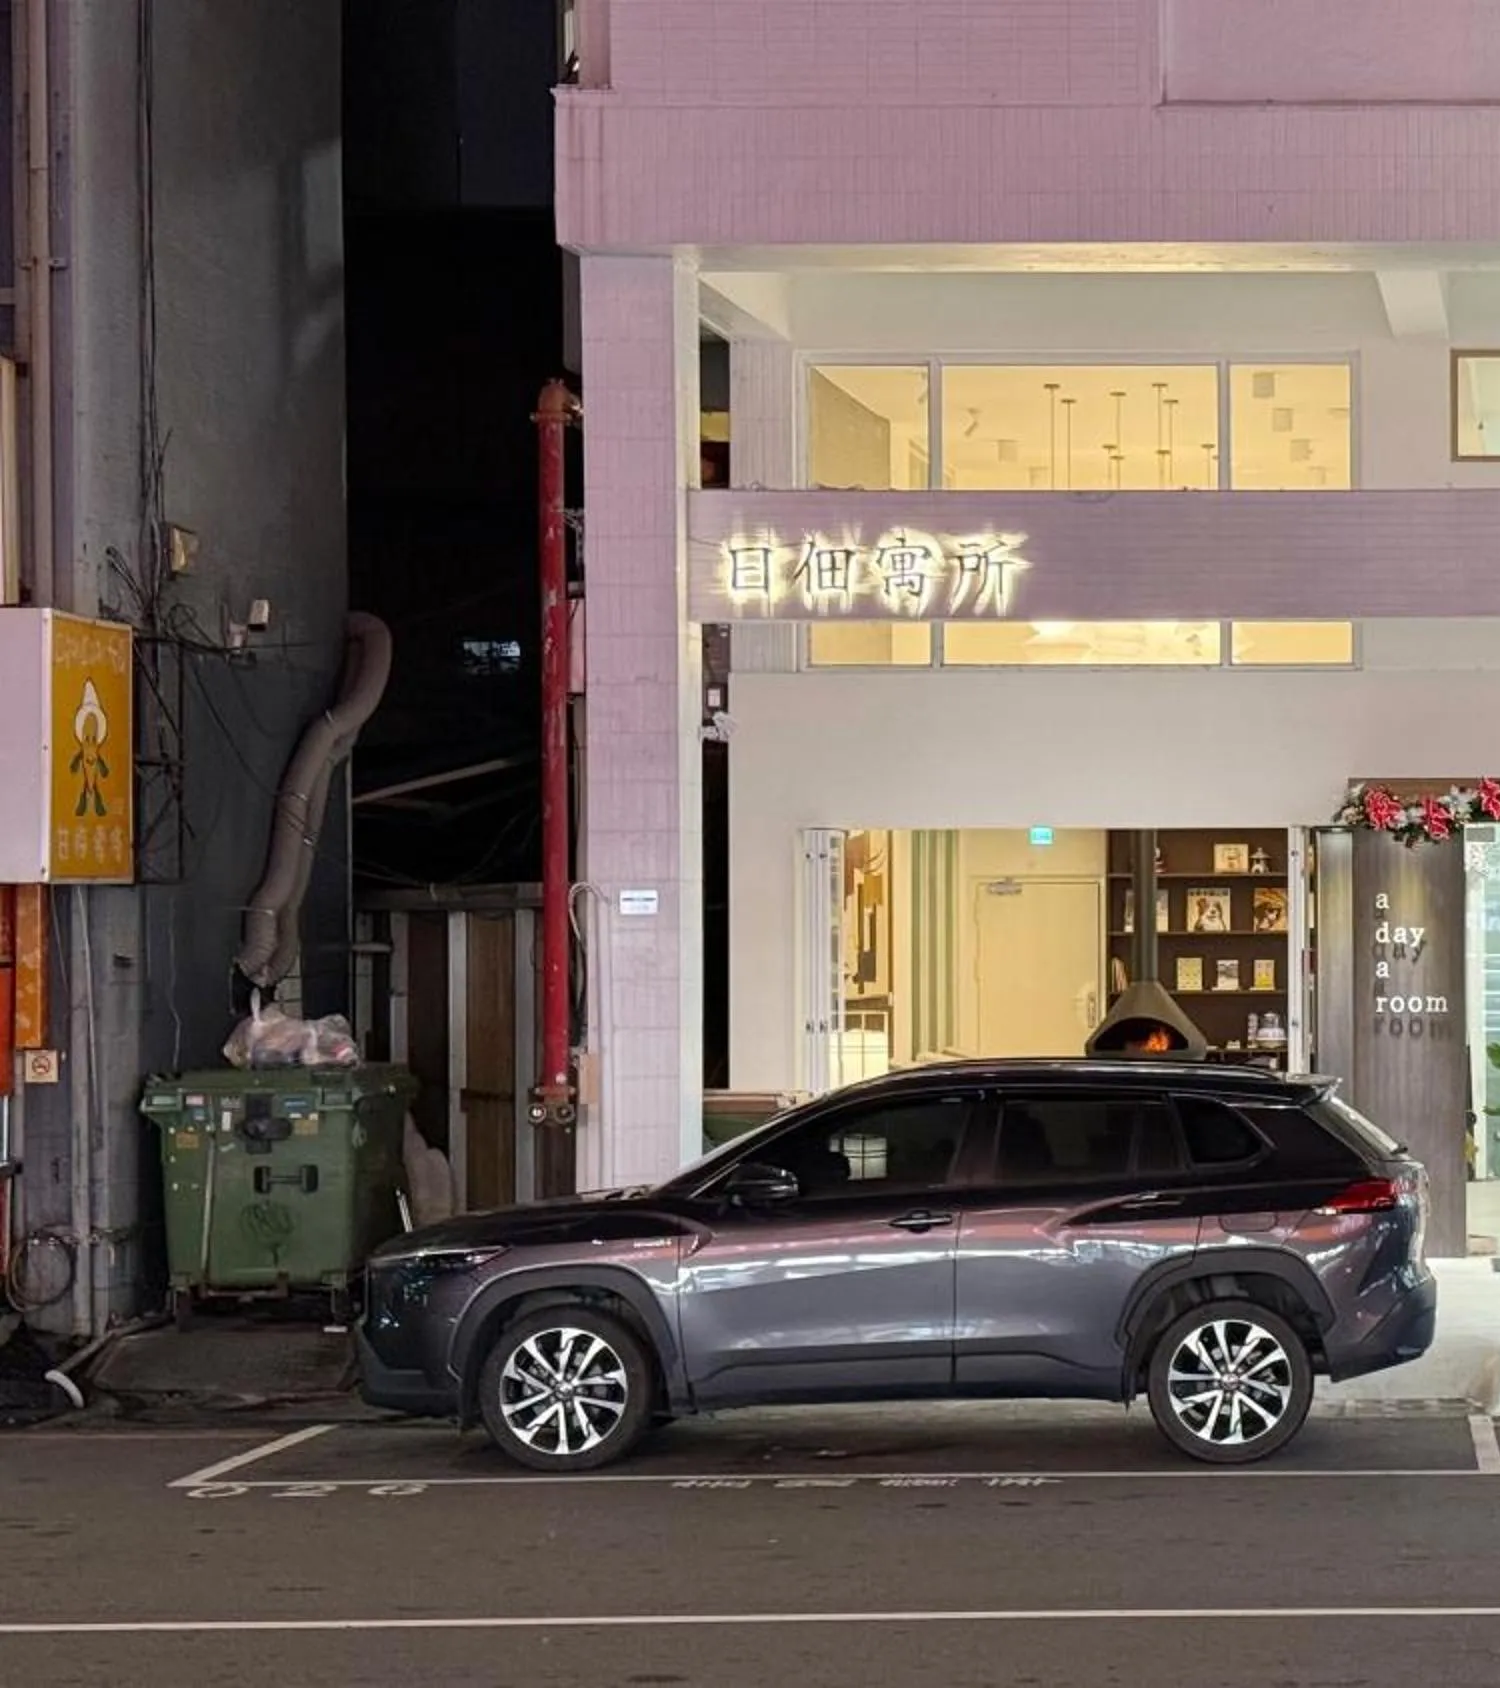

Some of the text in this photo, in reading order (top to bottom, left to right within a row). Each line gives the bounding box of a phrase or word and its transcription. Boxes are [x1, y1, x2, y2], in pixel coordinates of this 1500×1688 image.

[729, 537, 1013, 598] 日佃寓所
[1375, 893, 1390, 909] a
[1375, 921, 1425, 948] day
[1375, 960, 1390, 978] a
[1375, 994, 1448, 1013] room
